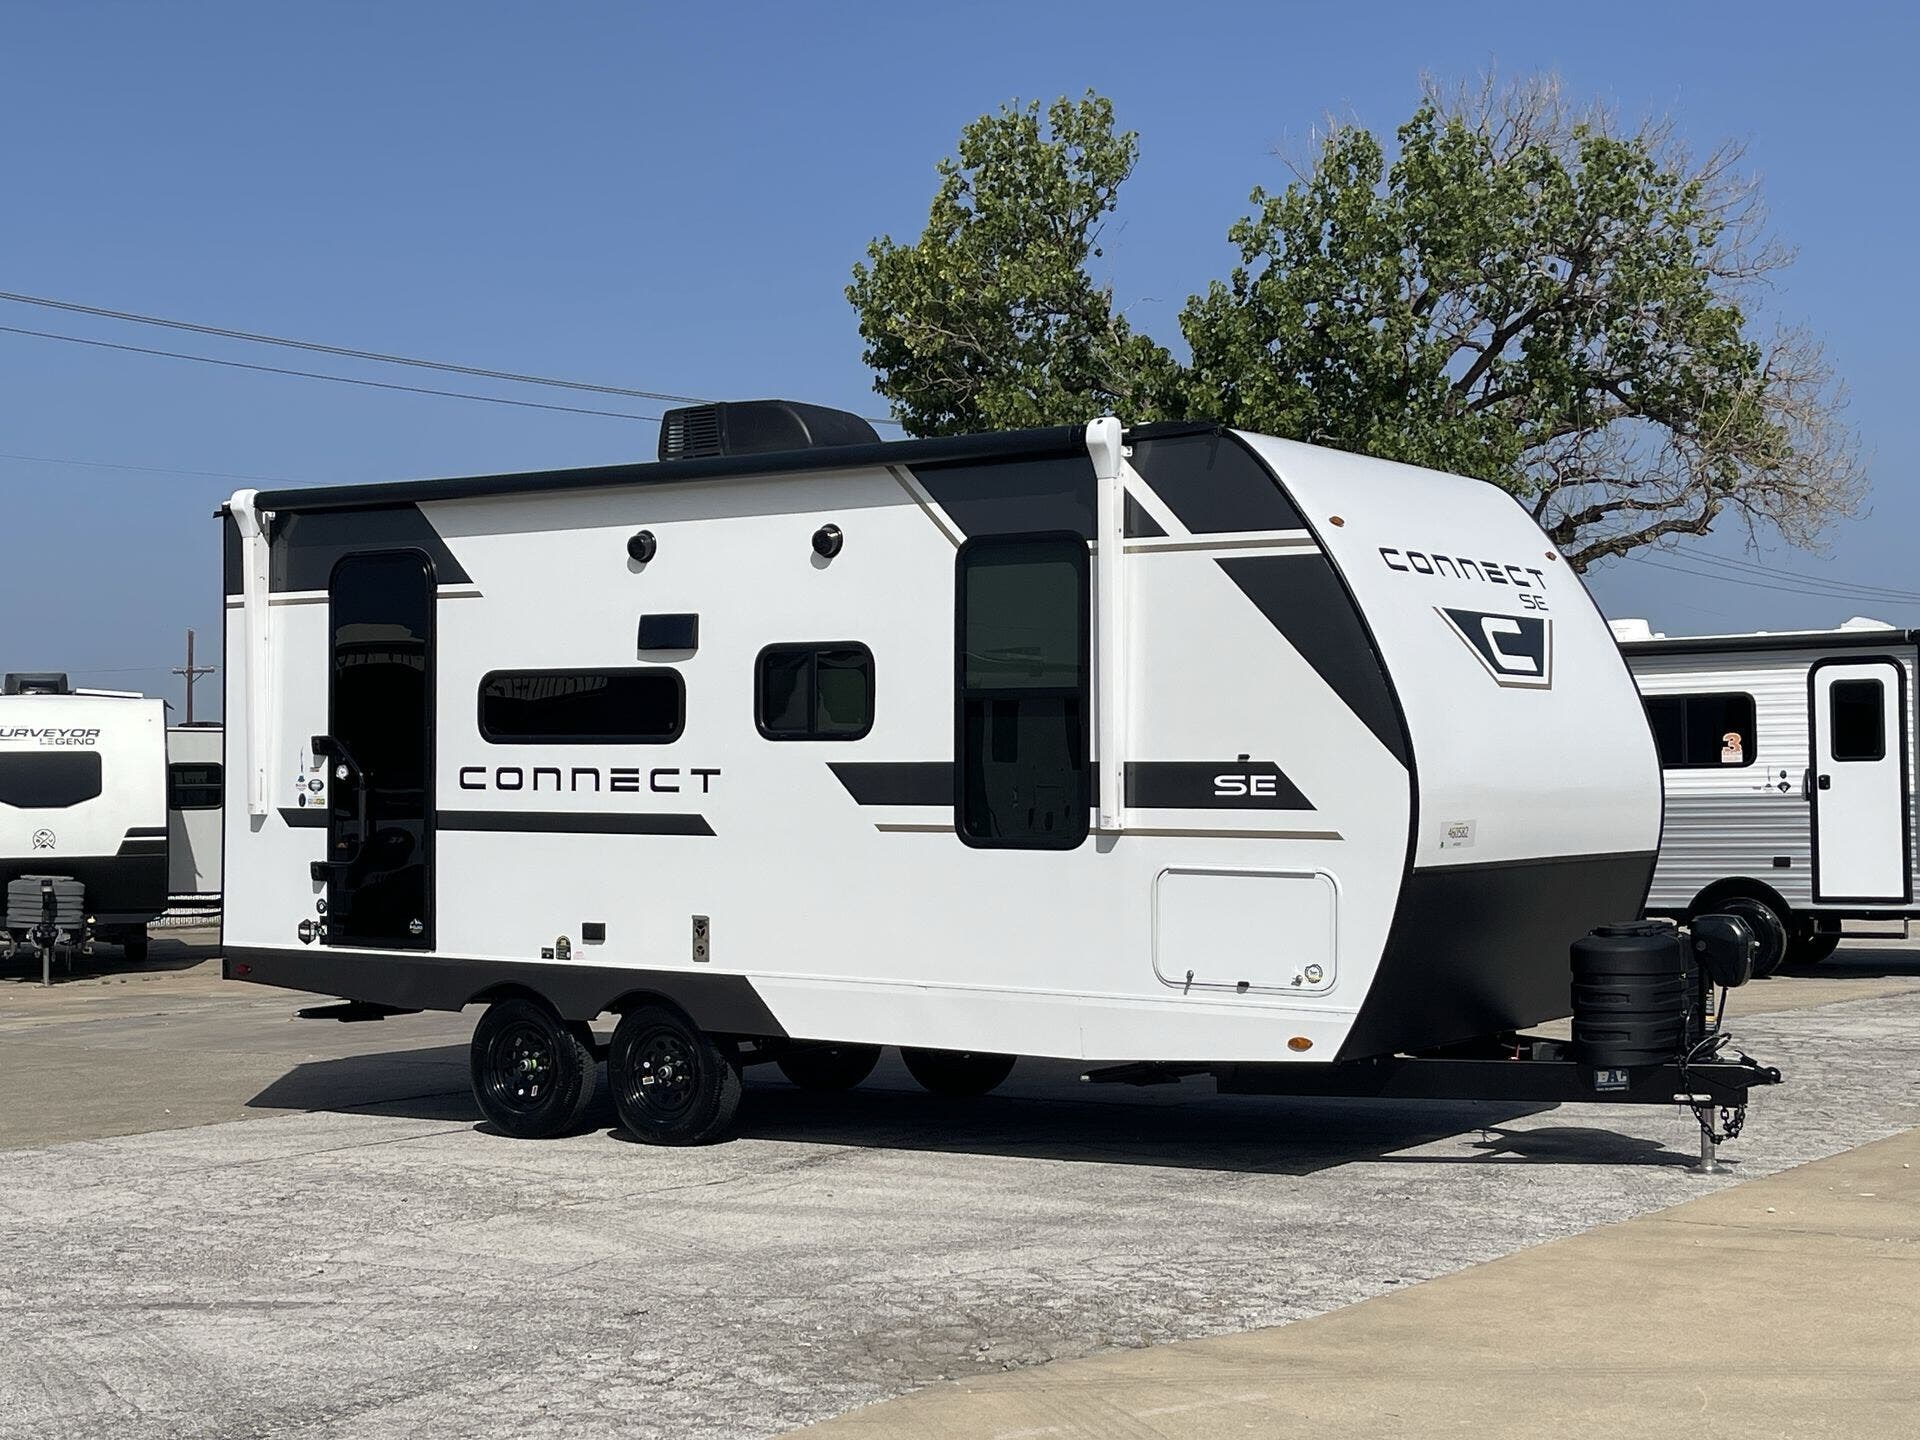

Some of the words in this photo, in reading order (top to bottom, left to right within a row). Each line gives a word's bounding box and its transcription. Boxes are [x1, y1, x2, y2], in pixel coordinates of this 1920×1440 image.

[1378, 547, 1546, 590] CONNECT
[1518, 593, 1549, 611] SE
[1480, 616, 1538, 672] C
[1722, 732, 1742, 752] 3
[459, 766, 721, 793] CONNECT
[1214, 775, 1277, 796] SE
